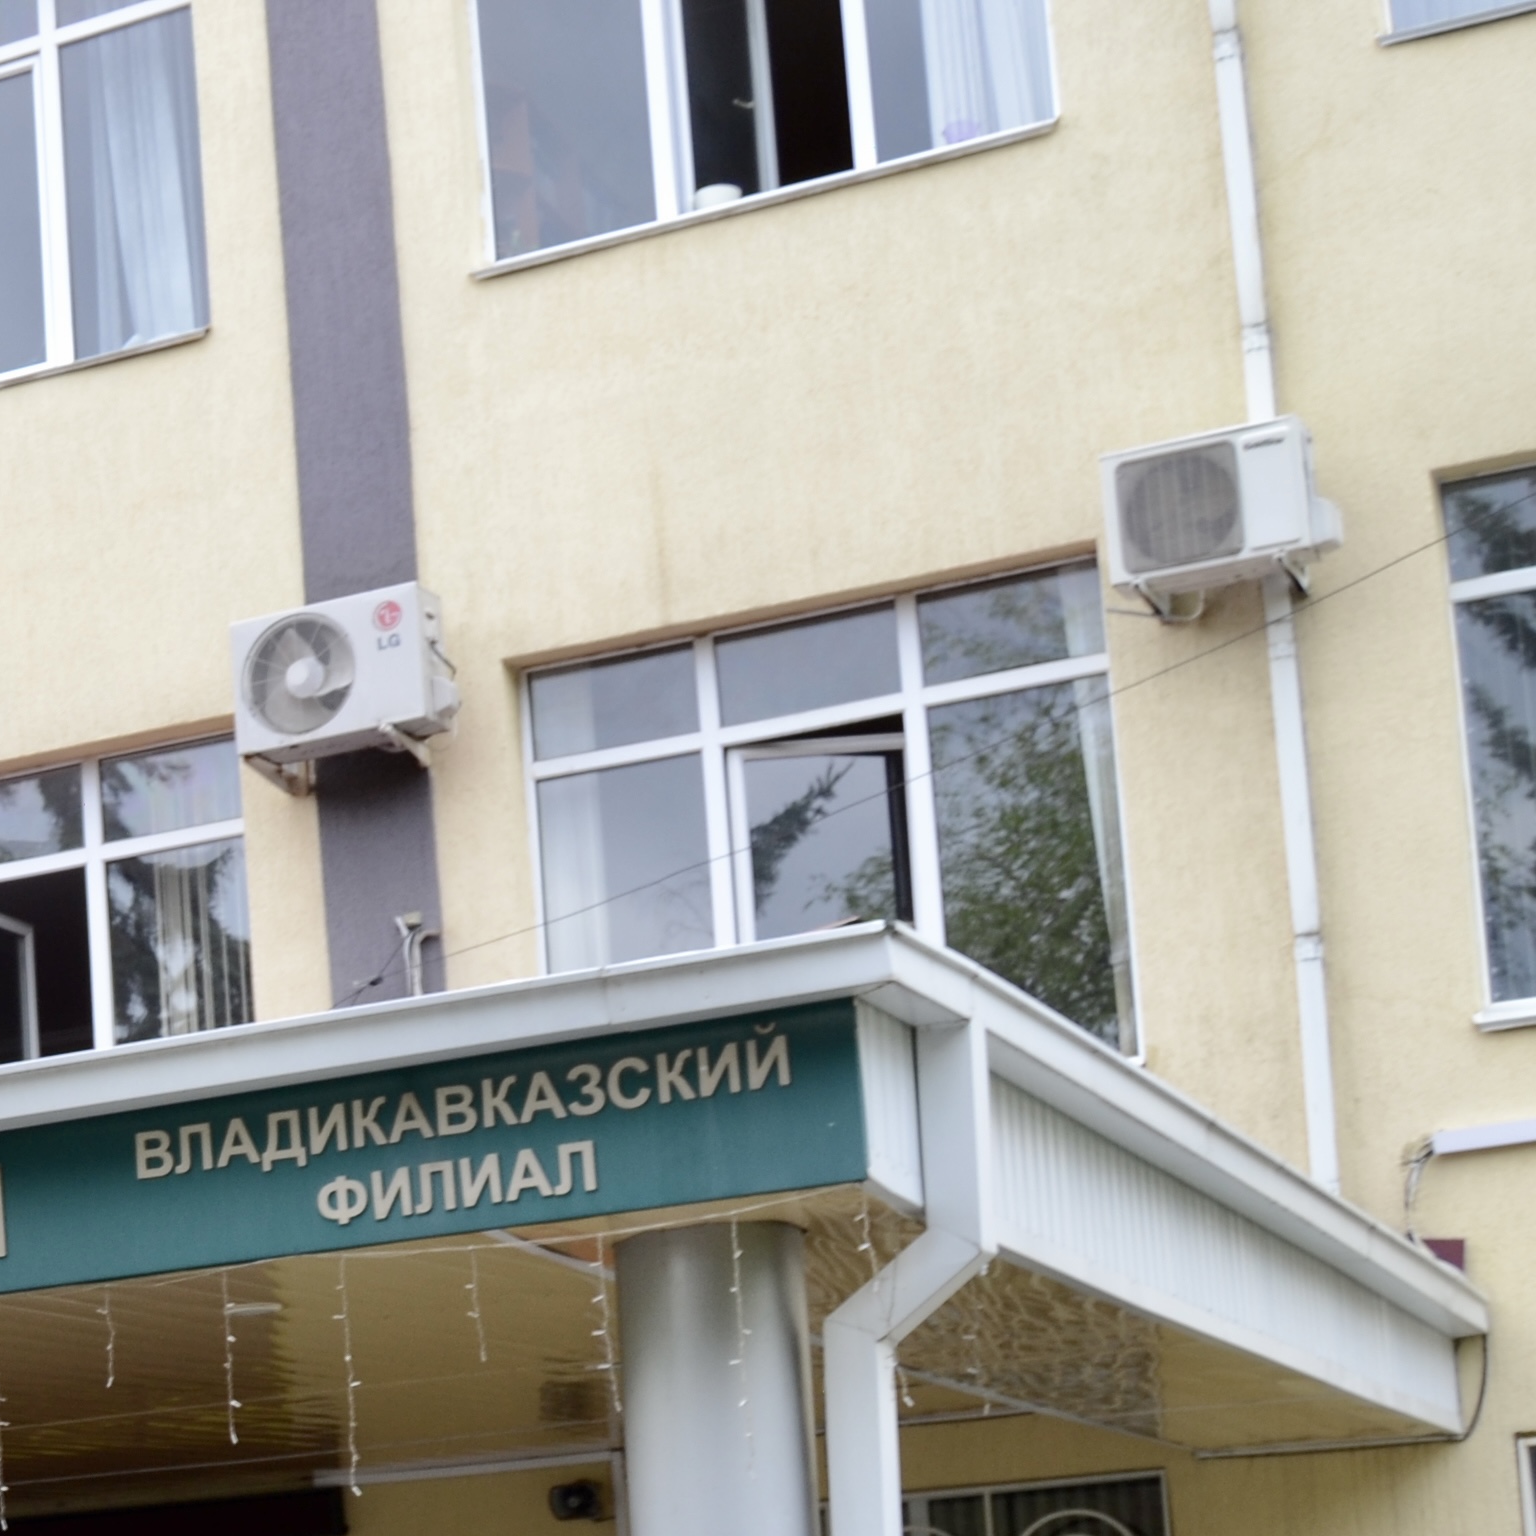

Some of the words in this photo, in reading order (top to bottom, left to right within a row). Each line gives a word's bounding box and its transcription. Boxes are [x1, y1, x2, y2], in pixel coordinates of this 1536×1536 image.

[376, 633, 401, 651] LG
[134, 1023, 790, 1182] ВЛАДИКАВКАЗСКИЙ
[316, 1141, 599, 1225] ФИЛИАЛ
